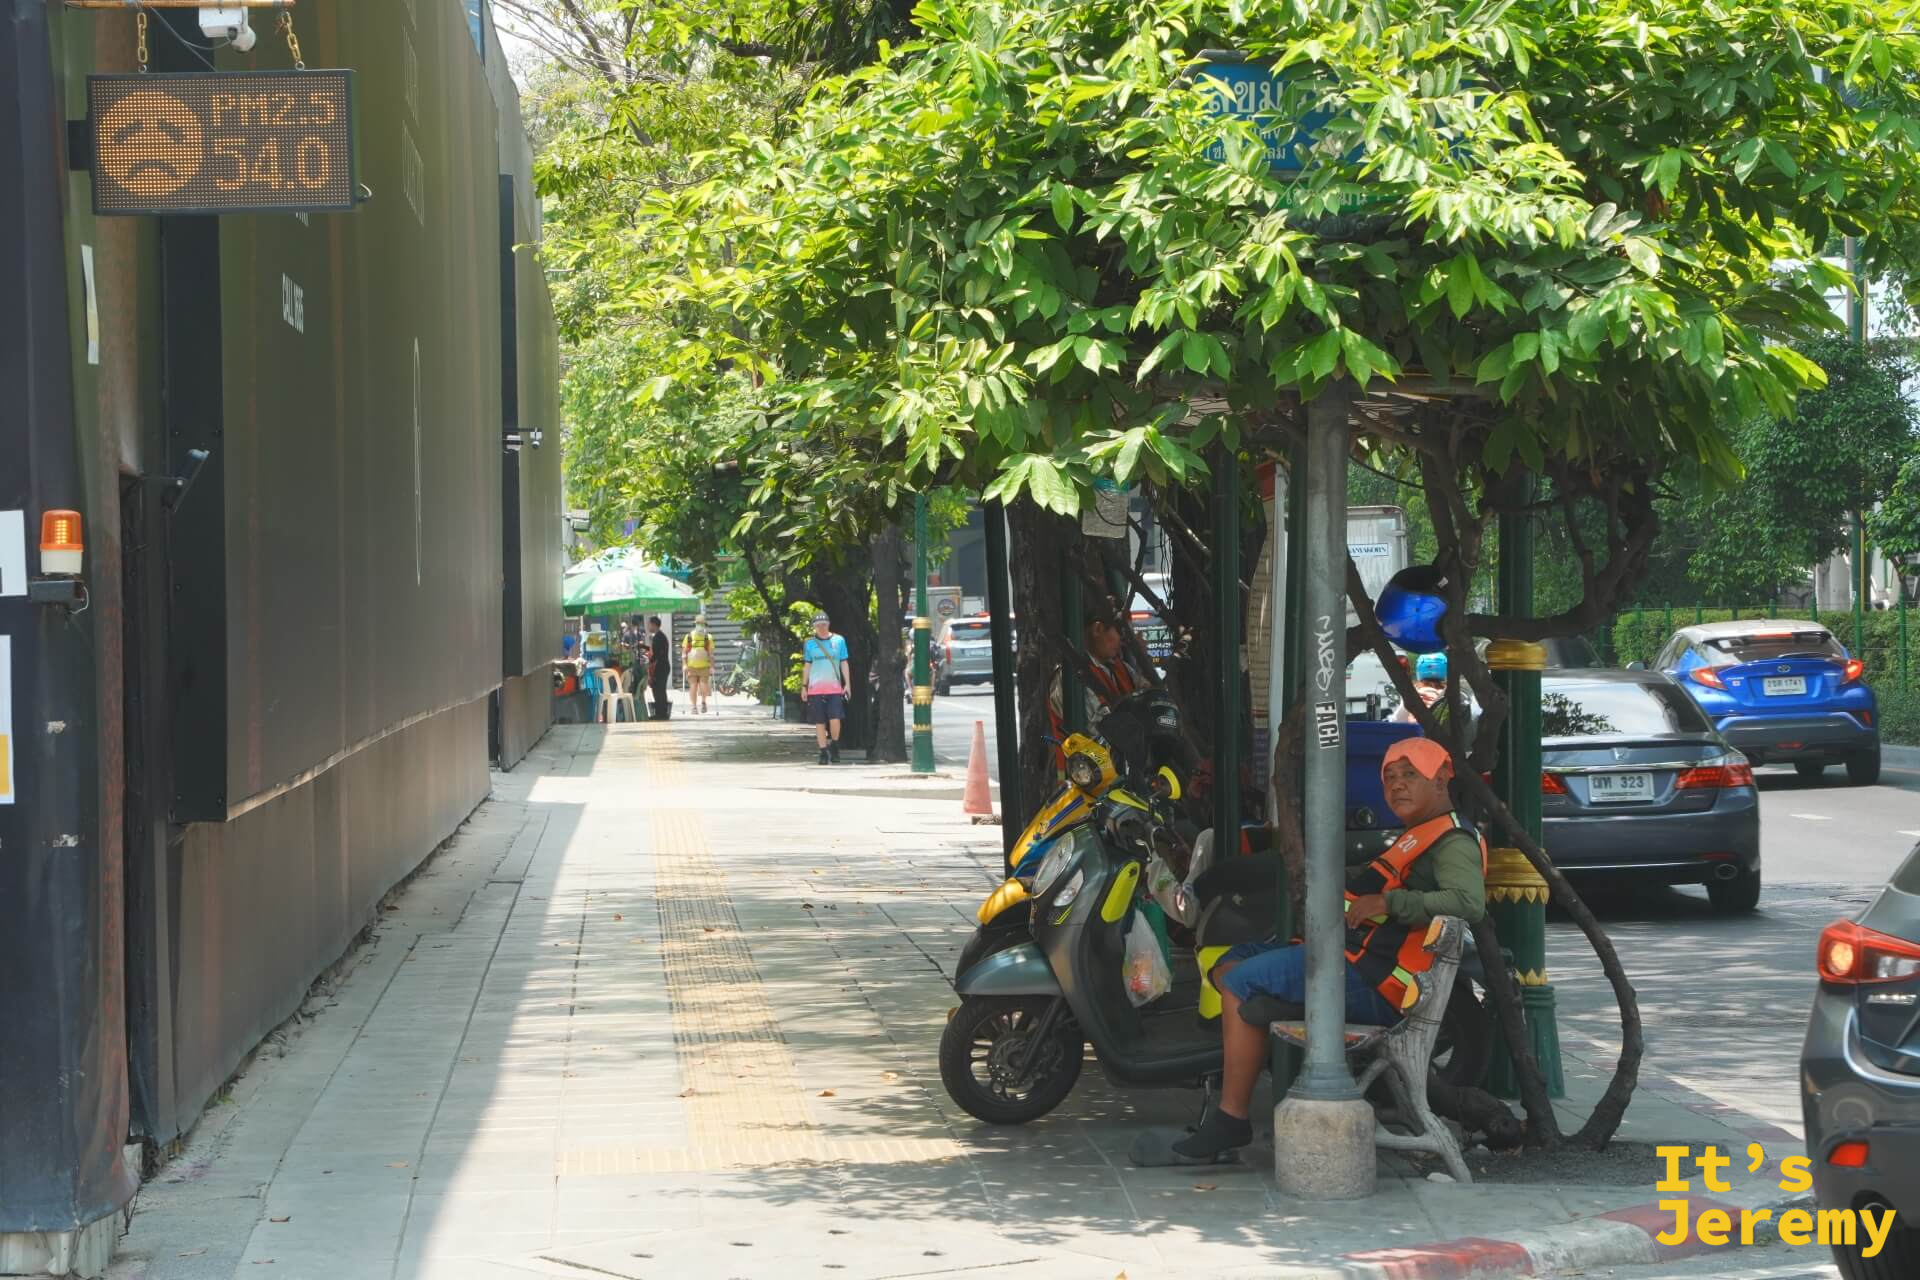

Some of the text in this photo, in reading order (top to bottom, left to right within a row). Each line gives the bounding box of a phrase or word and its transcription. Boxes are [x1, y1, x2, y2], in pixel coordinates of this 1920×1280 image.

[212, 92, 336, 126] PM2.5
[213, 136, 330, 190] 54.0
[282, 272, 294, 327] CALL
[1316, 702, 1339, 748] FACH
[1620, 775, 1644, 789] 323
[1398, 834, 1418, 853] 20
